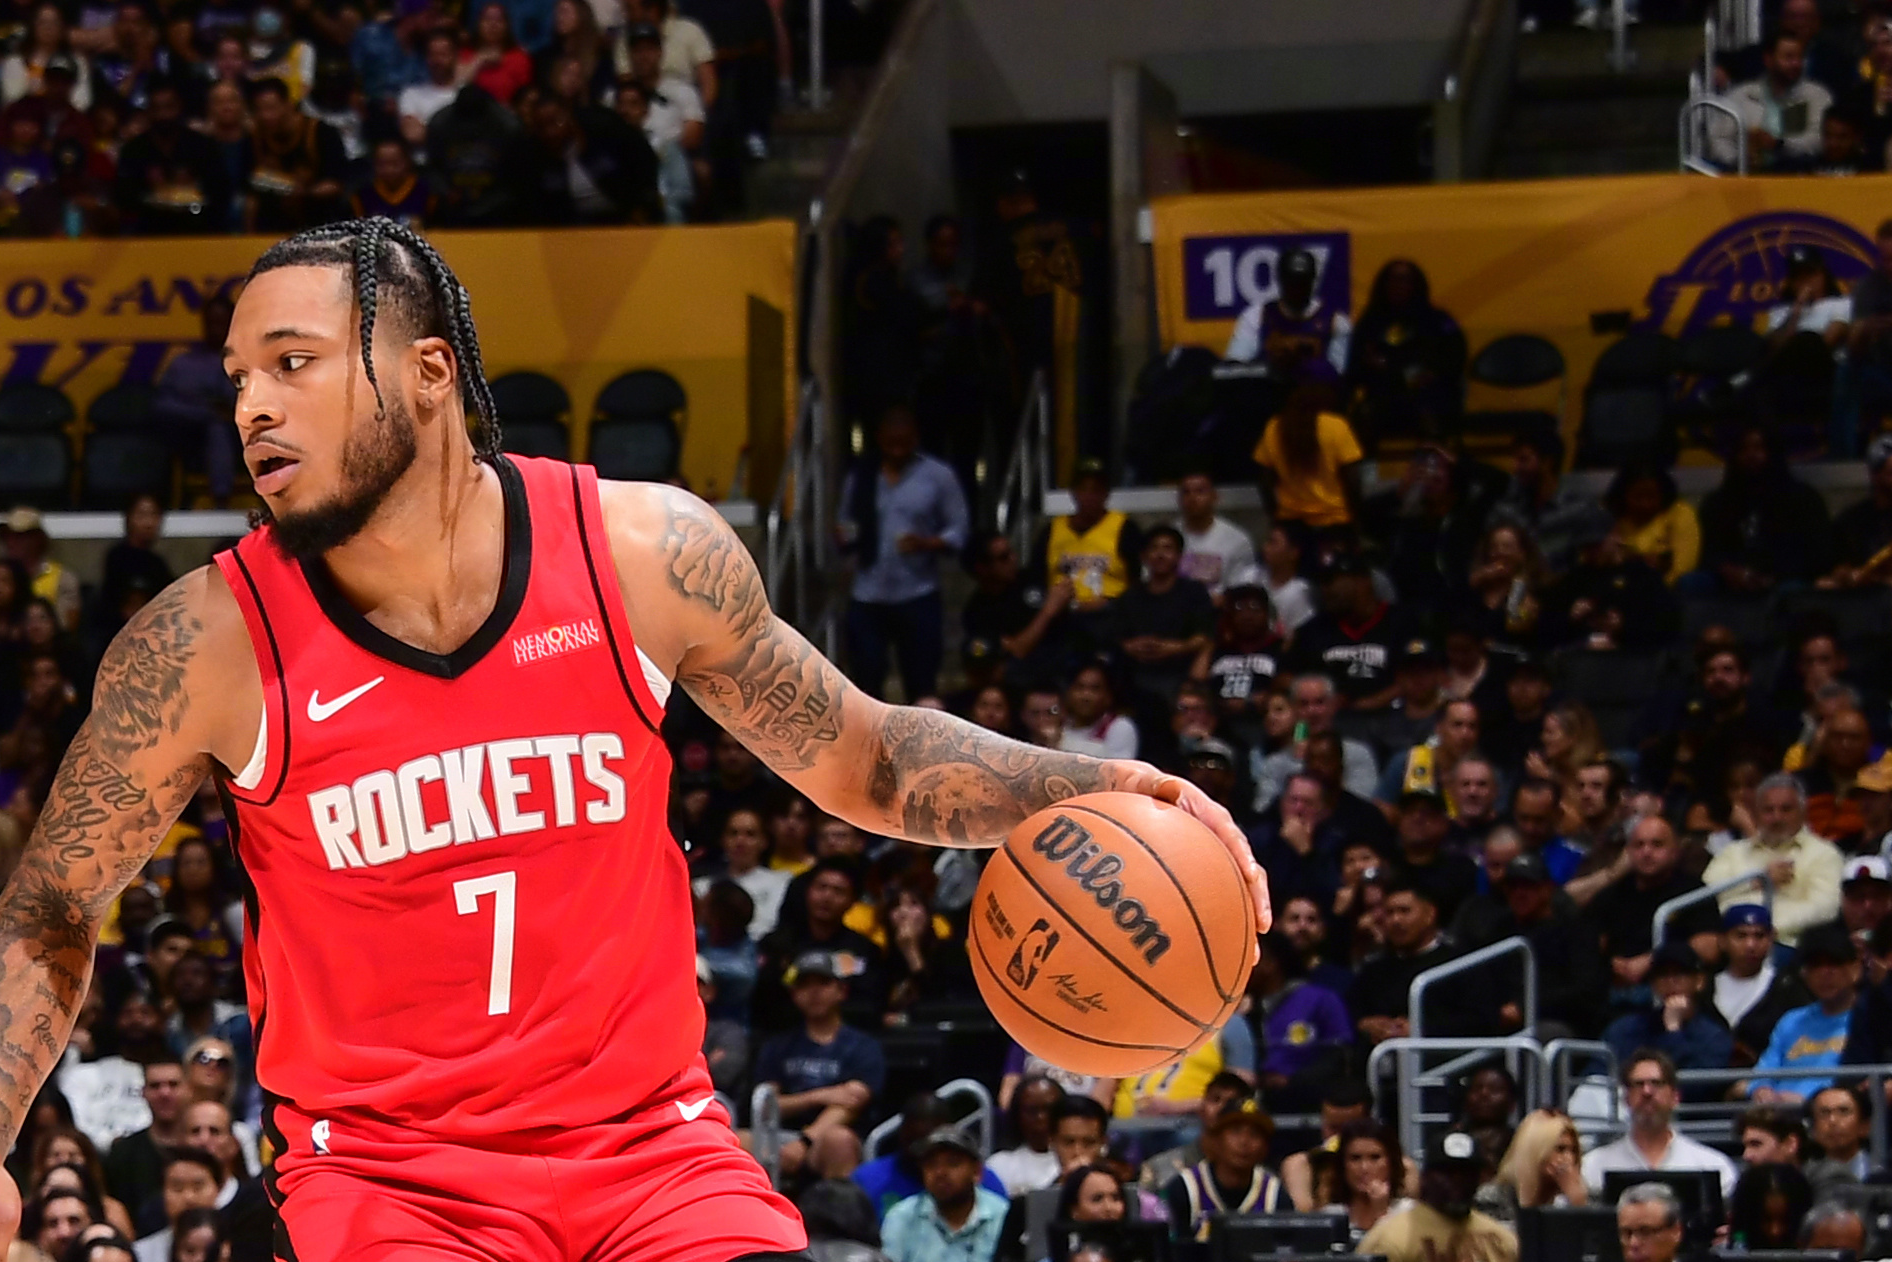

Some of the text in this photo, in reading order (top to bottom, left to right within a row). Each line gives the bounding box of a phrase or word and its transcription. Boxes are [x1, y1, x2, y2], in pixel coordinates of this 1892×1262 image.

[512, 618, 599, 653] MEMORIAL
[514, 626, 600, 664] HERMANN
[307, 732, 626, 871] ROCKETS
[453, 870, 517, 1016] 7
[1032, 813, 1172, 968] Wilson
